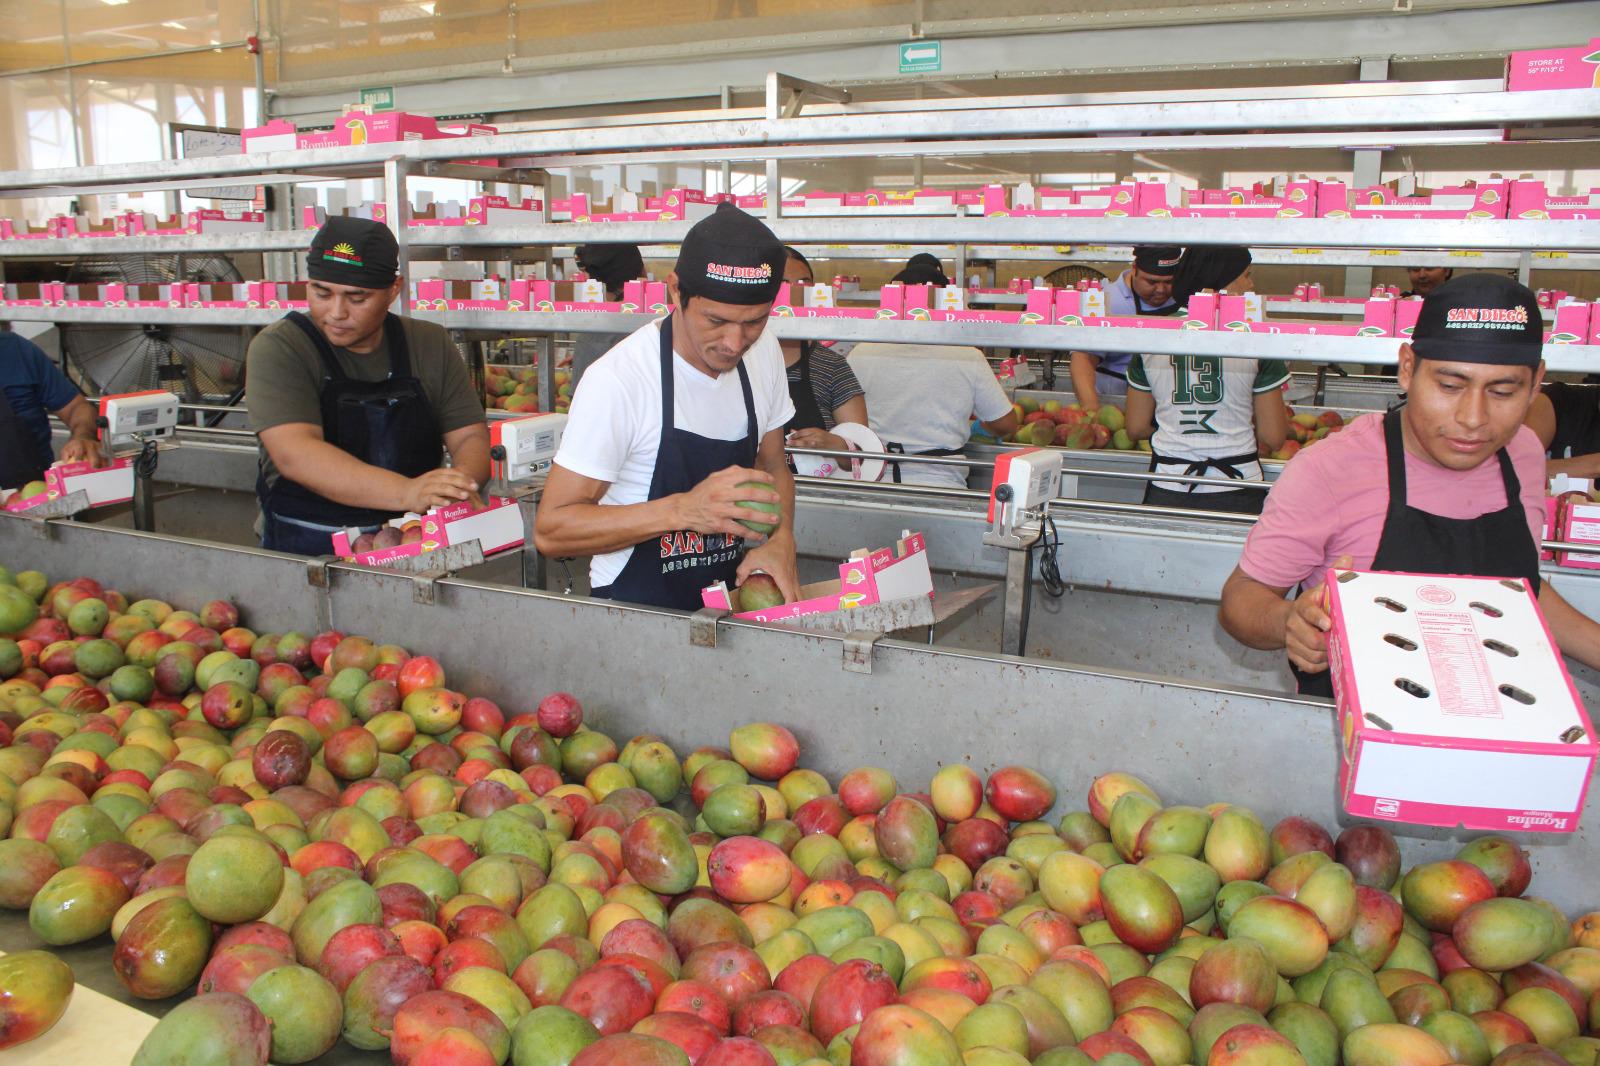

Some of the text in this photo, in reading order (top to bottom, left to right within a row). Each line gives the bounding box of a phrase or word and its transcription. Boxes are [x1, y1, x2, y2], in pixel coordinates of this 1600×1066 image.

[706, 262, 769, 279] SAN DIEGO
[1447, 308, 1525, 324] SAN DIEGO
[1170, 355, 1223, 404] 13
[660, 531, 704, 558] SAN
[1506, 815, 1569, 830] Romina
